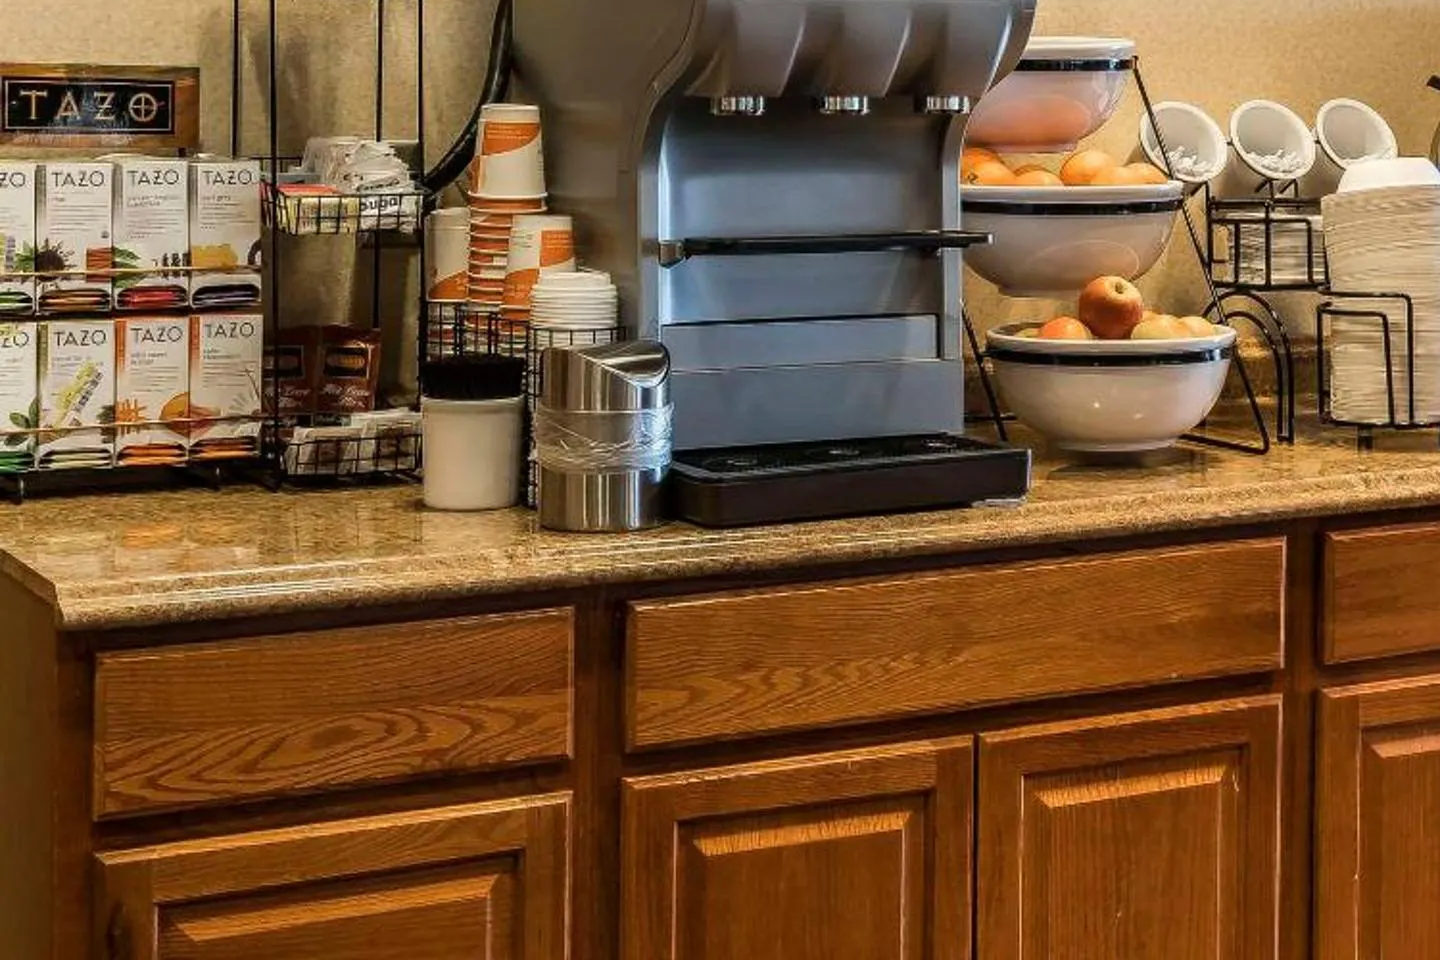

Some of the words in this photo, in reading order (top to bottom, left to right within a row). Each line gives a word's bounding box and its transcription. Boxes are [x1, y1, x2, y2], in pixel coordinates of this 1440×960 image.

[19, 90, 159, 122] TAZO
[0, 171, 26, 188] ZO
[51, 170, 105, 187] TAZO
[127, 169, 180, 186] TAZO
[202, 169, 252, 186] TAZO
[54, 329, 107, 347] TAZO
[130, 325, 183, 343] TAZO
[203, 321, 255, 339] TAZO
